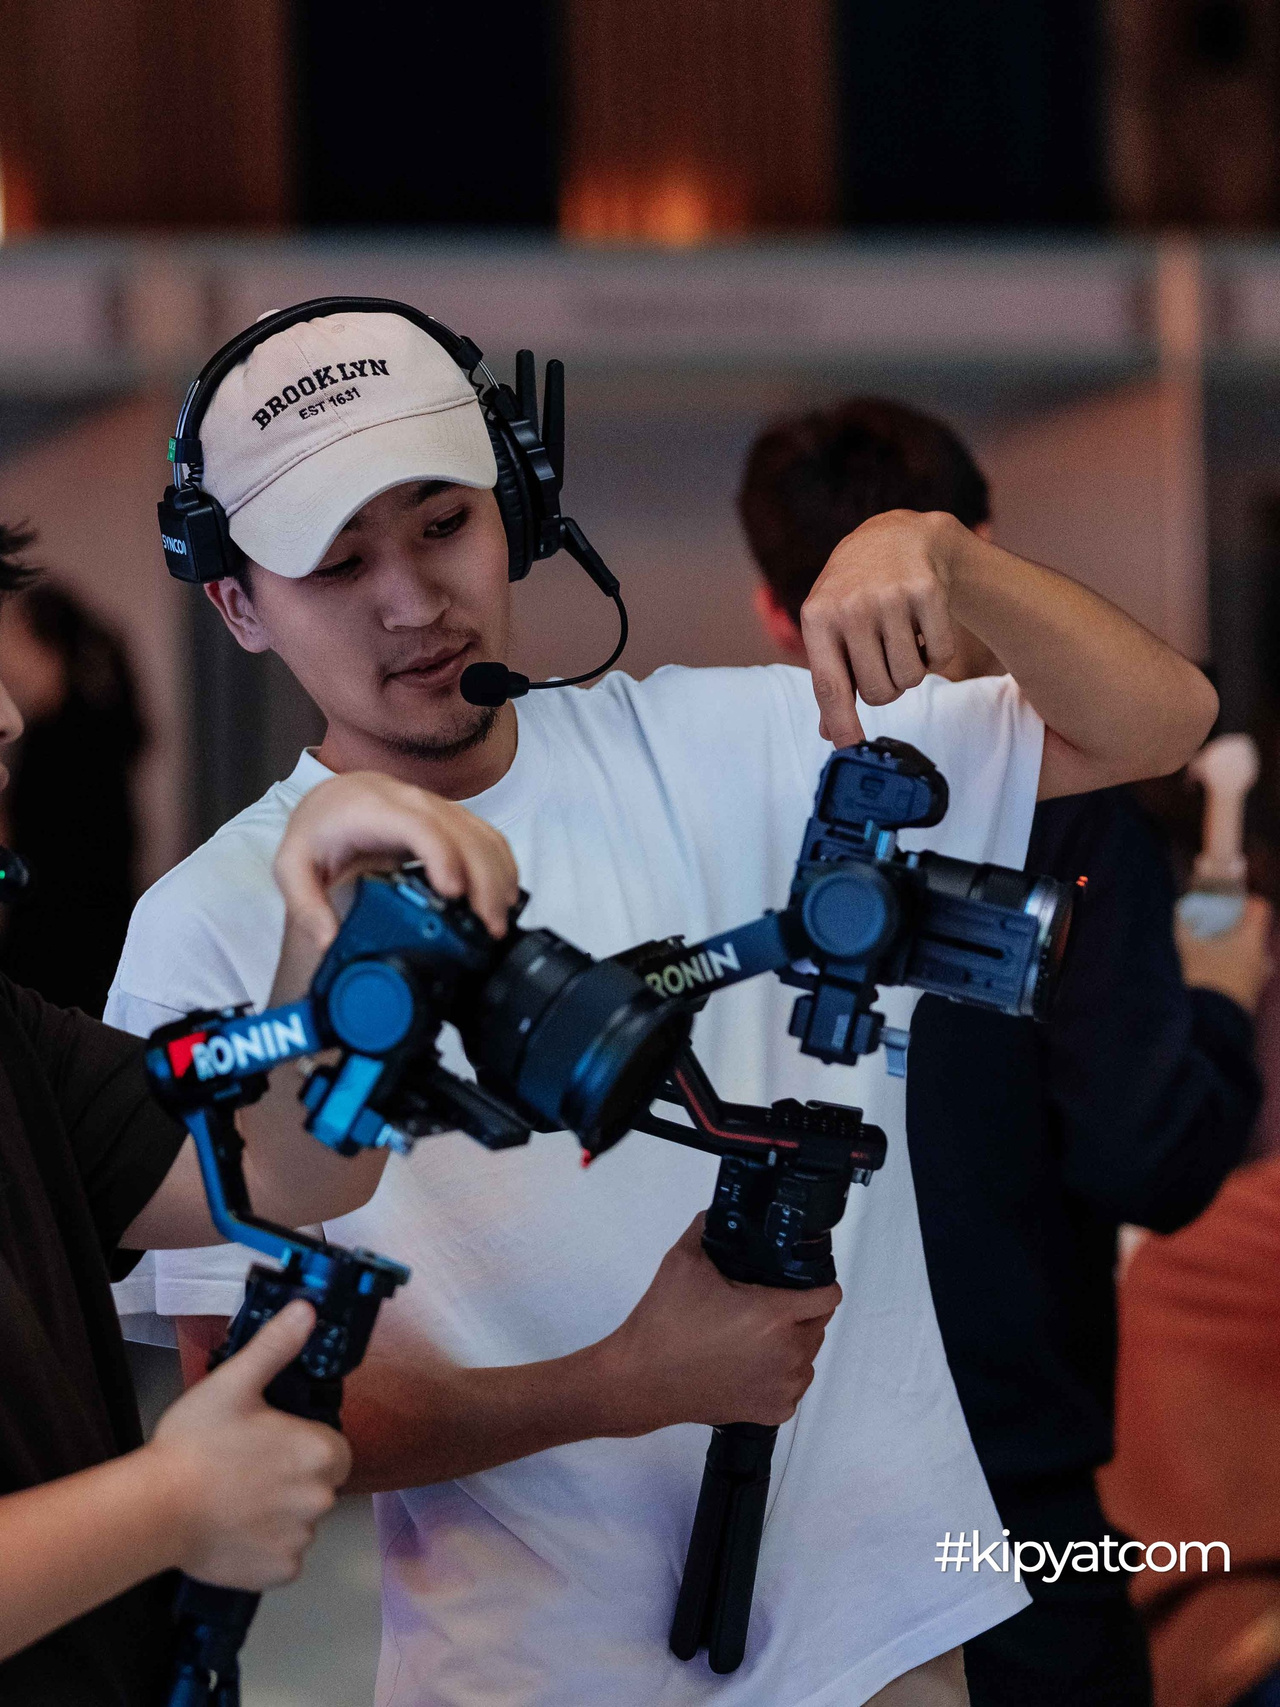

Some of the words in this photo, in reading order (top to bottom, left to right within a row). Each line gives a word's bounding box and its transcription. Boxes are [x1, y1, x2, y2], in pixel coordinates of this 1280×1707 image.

[252, 359, 390, 430] BROOKLYN
[298, 401, 326, 420] EST
[328, 387, 361, 407] 1631
[192, 1012, 308, 1081] RONIN
